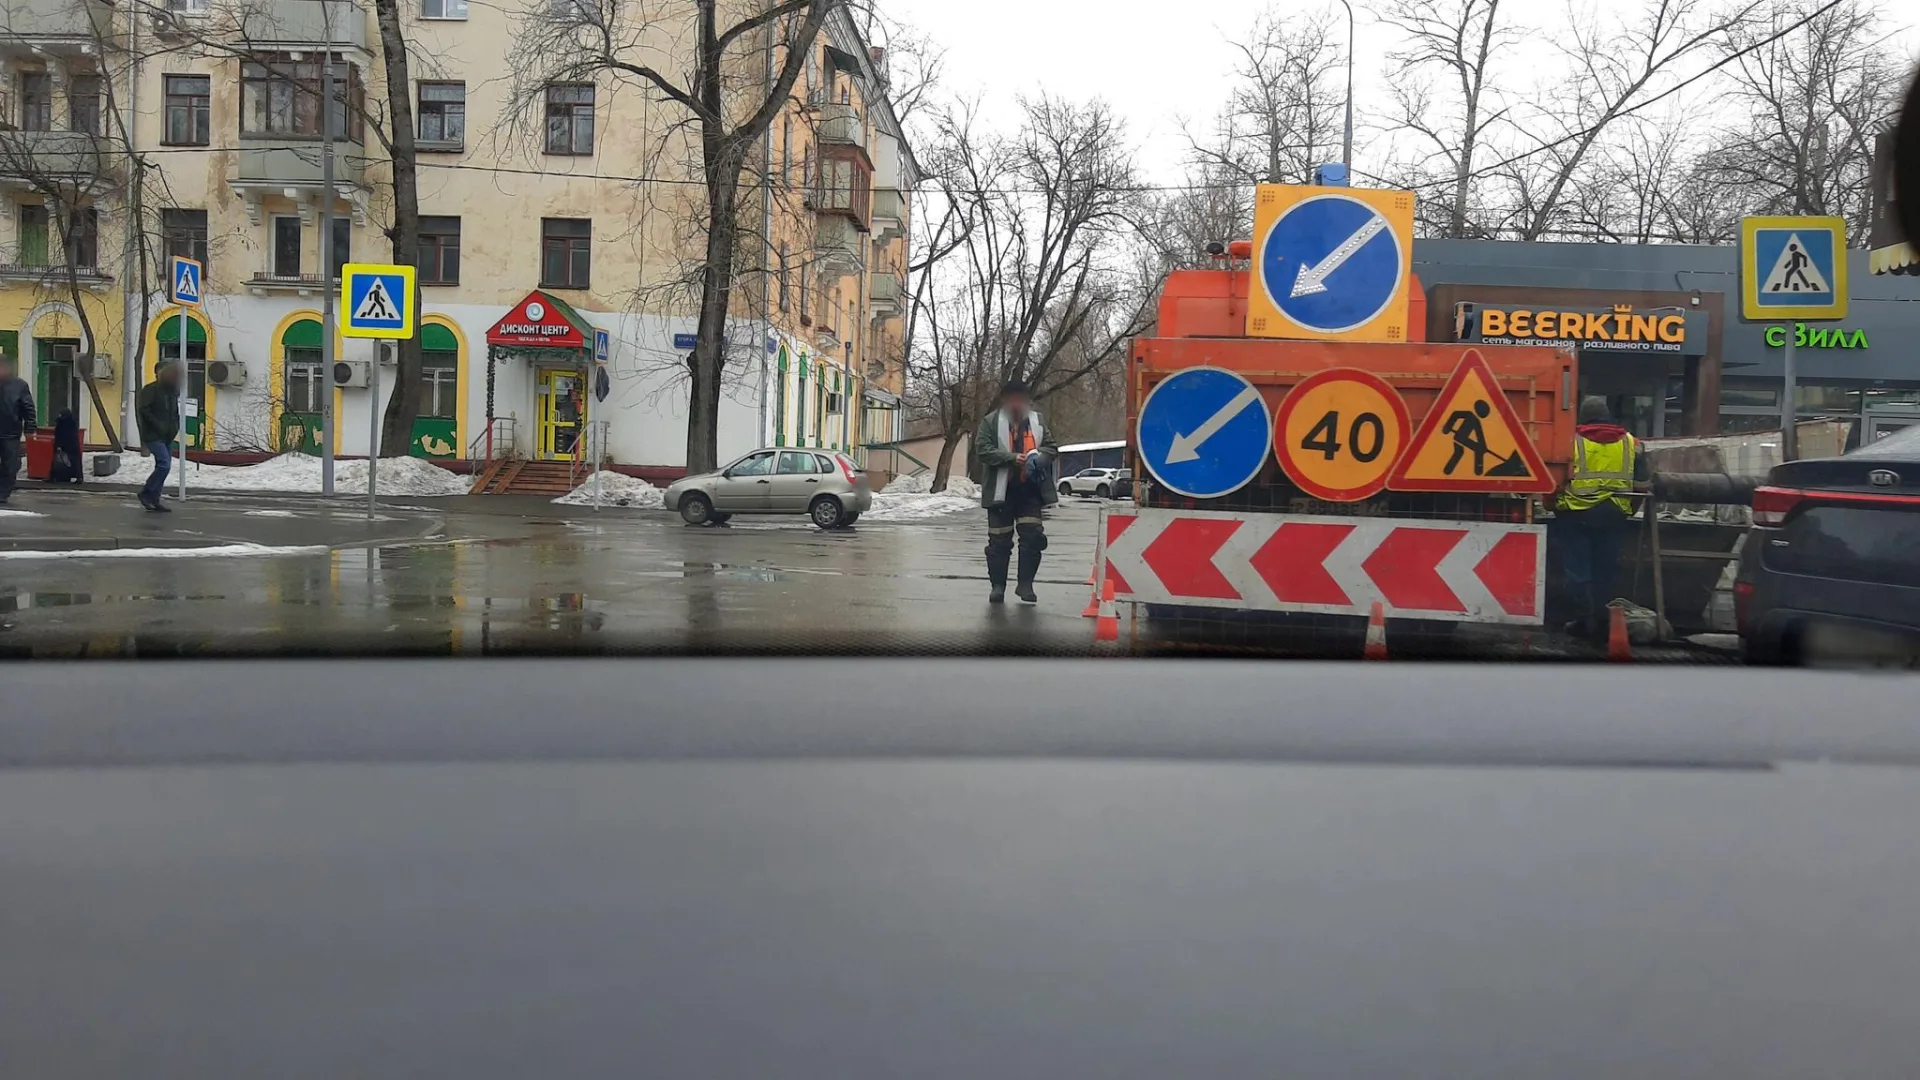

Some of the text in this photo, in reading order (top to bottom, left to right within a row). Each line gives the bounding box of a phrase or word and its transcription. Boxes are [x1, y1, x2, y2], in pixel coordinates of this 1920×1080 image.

[500, 324, 570, 336] ДИСКОНТ ЦЕНТР
[1481, 309, 1685, 342] BEERKING
[1482, 336, 1681, 351] сеть магазинов разливного пива
[1301, 410, 1385, 463] 40
